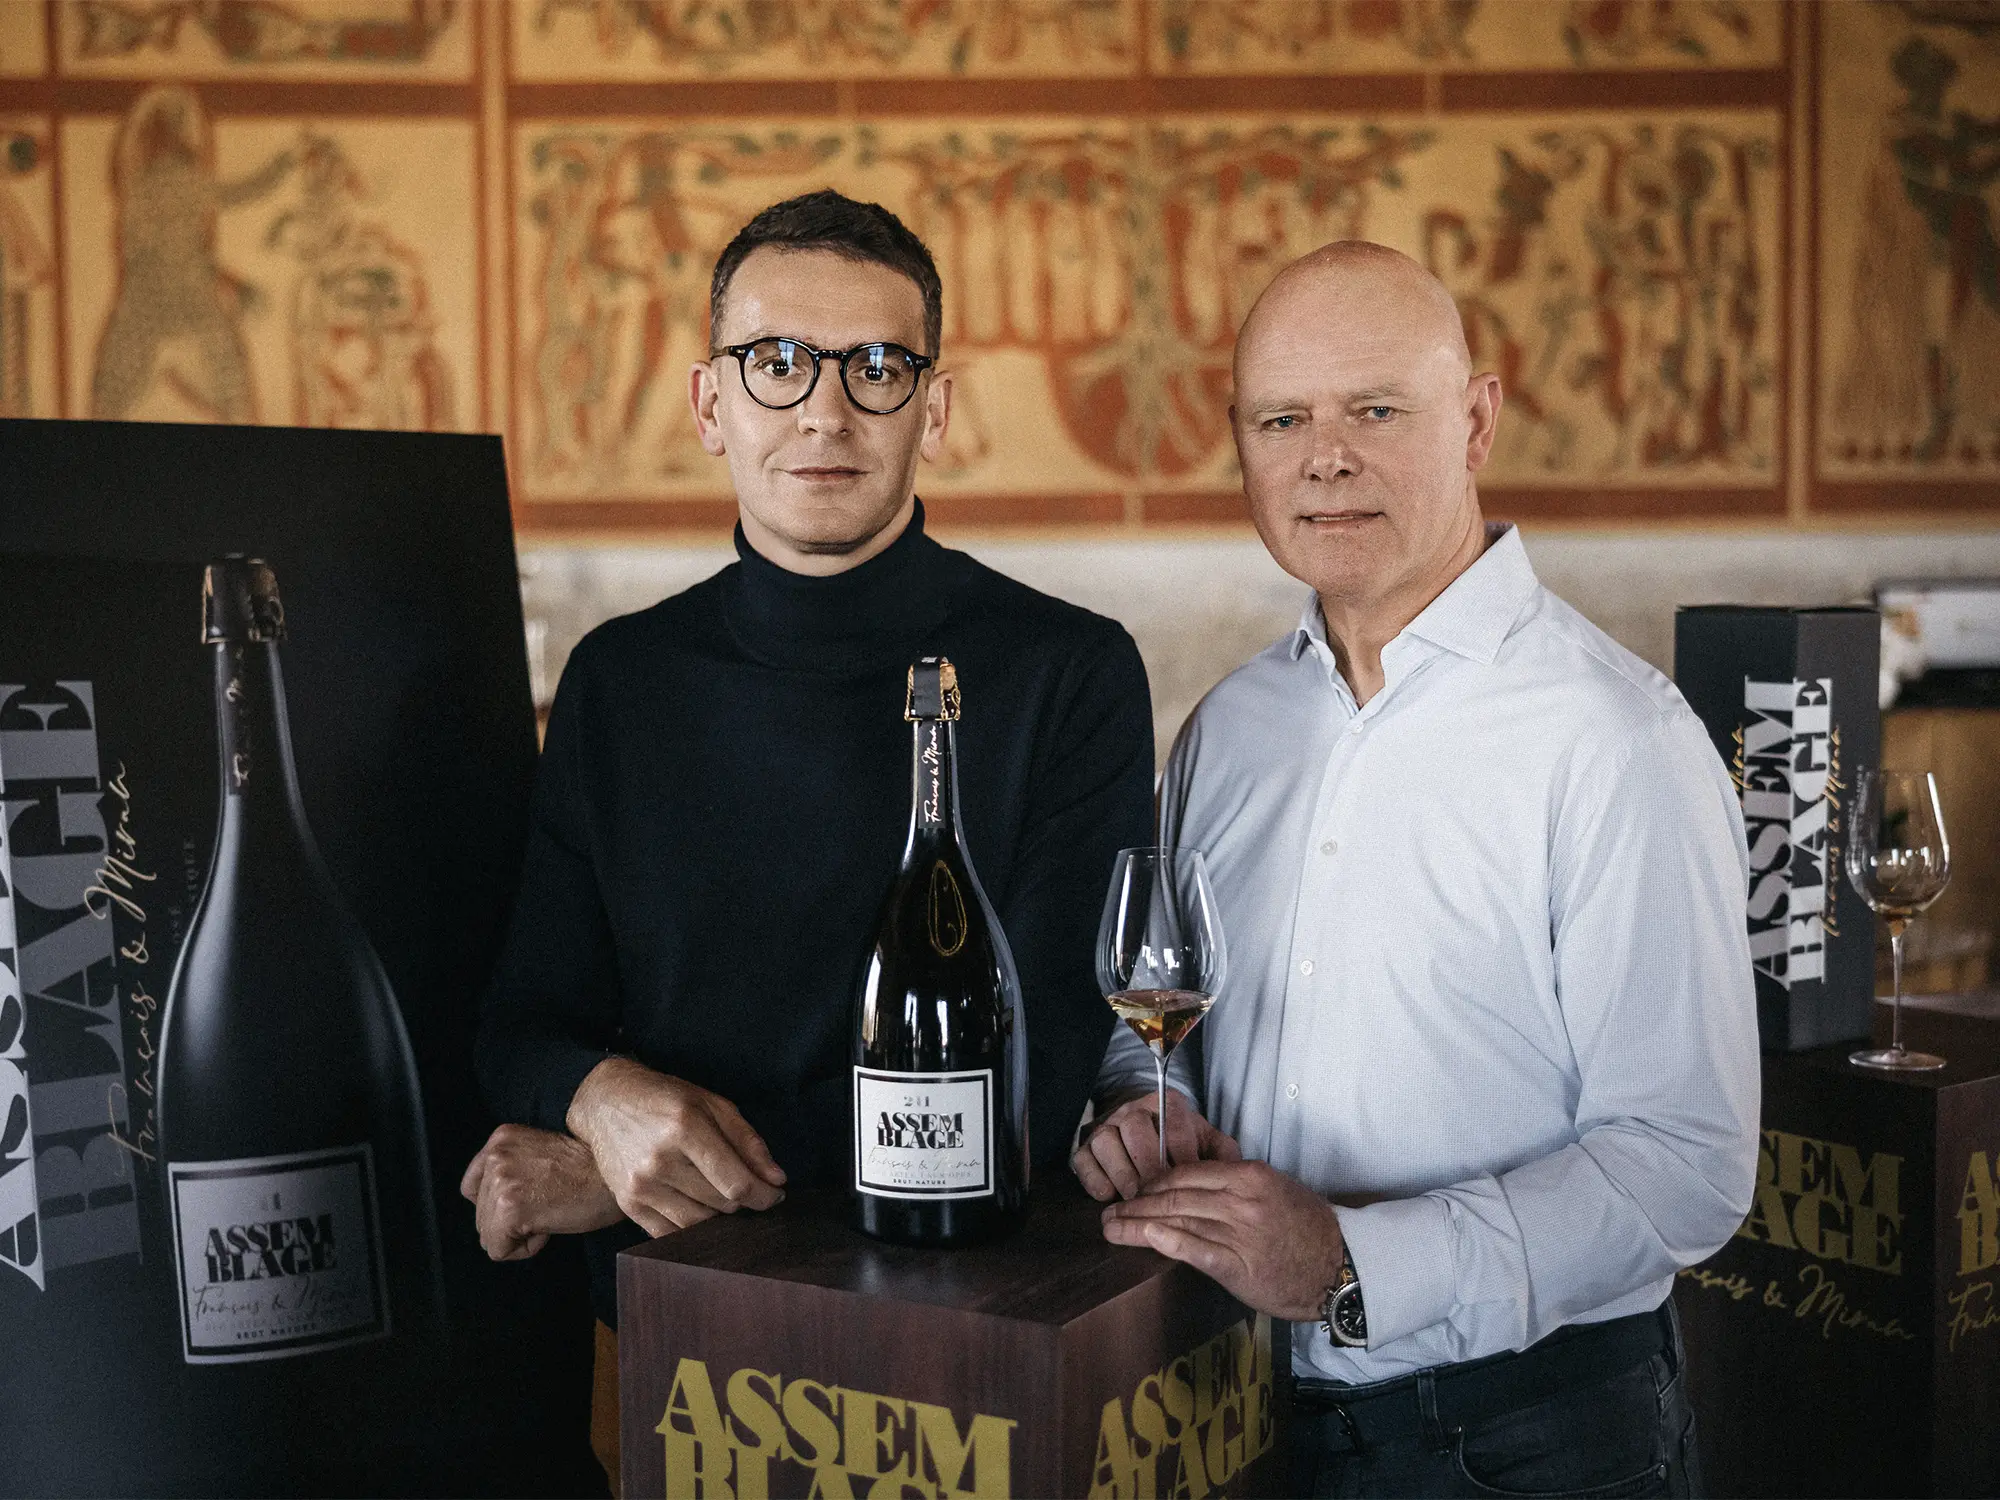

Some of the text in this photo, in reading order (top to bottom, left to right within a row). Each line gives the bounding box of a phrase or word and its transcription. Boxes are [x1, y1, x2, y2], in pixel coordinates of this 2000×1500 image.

[1744, 674, 1796, 990] ASSEM
[1788, 677, 1833, 984] BLAGE
[120, 930, 152, 964] &
[876, 1111, 964, 1134] ASSEM
[876, 1127, 964, 1150] BLAGE
[205, 1214, 333, 1256] ASSEM
[1736, 1179, 1904, 1275] AGE
[207, 1243, 334, 1283] BLAGE
[1763, 1281, 1788, 1309] &
[1090, 1311, 1273, 1488] ASSEM
[655, 1357, 1019, 1491] ASSEM
